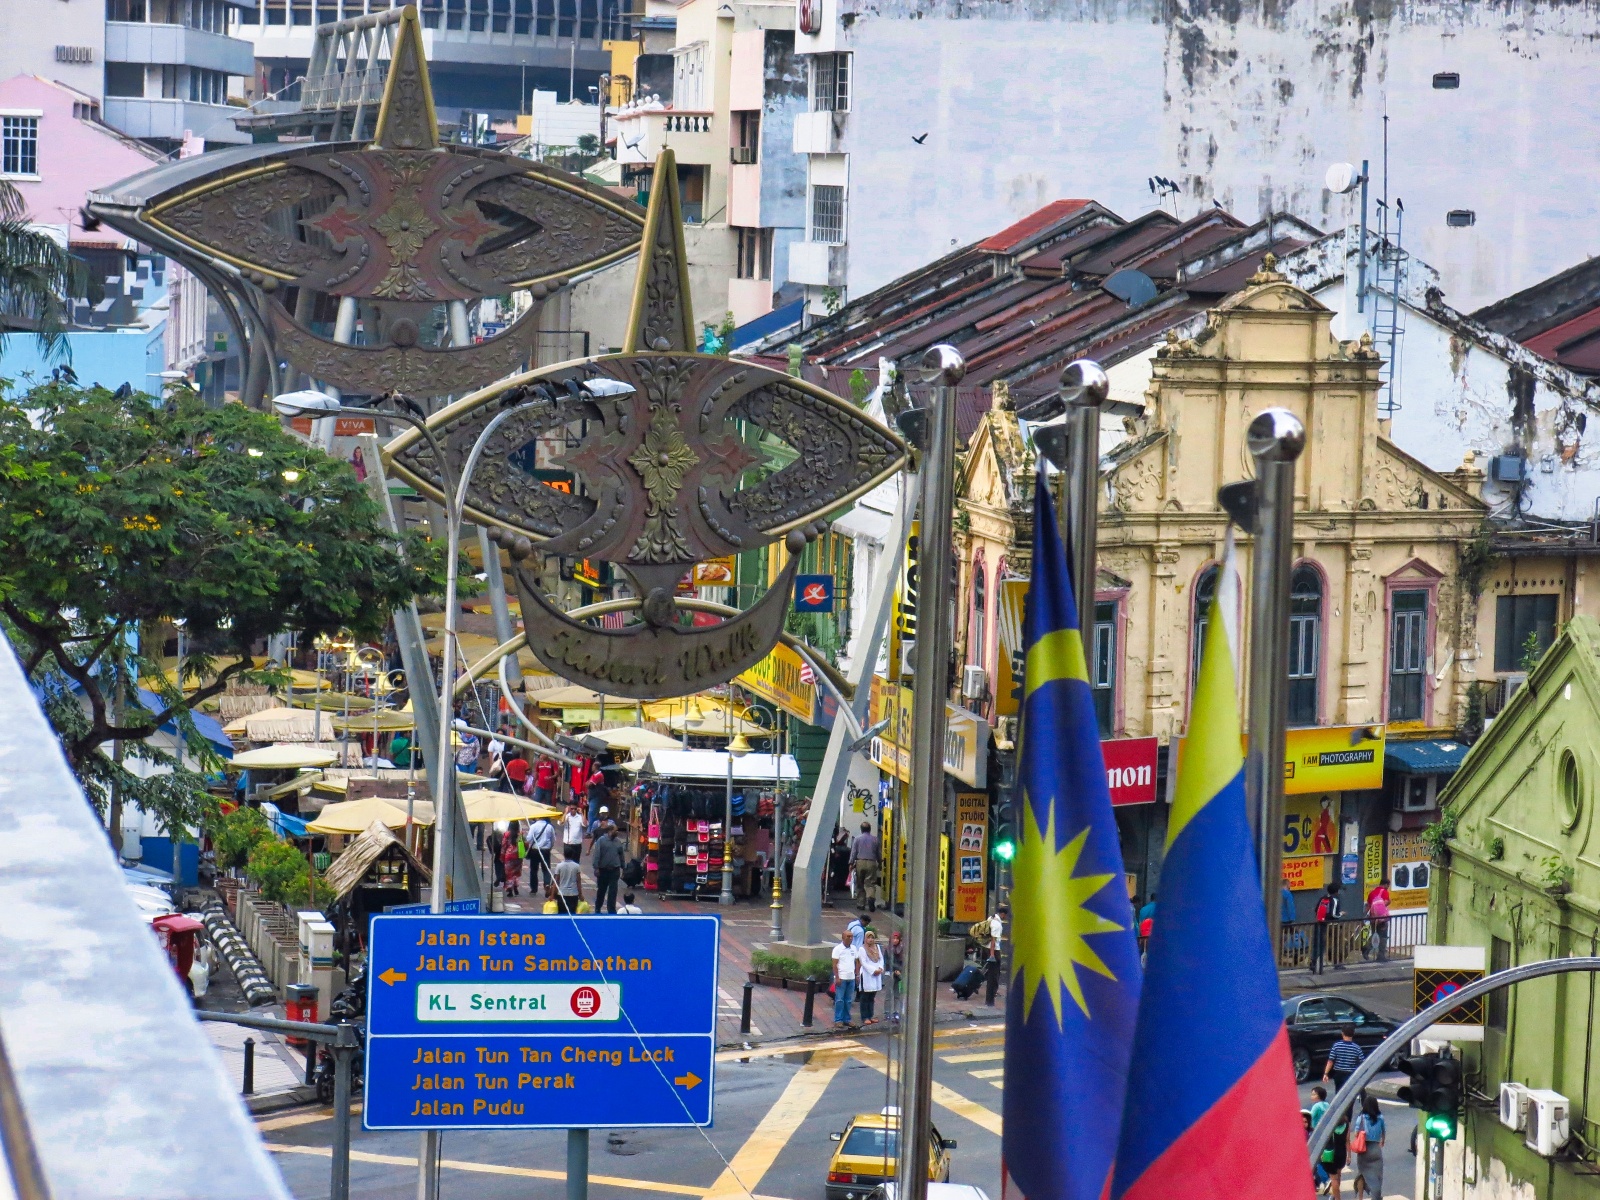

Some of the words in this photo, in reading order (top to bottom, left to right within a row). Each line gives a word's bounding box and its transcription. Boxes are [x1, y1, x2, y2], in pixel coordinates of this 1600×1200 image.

[1306, 755, 1318, 765] AM
[1320, 751, 1374, 764] PHOTOGRAPHY
[1107, 764, 1151, 789] non
[960, 798, 985, 807] DIGITAL
[960, 812, 985, 821] STUDIO
[1392, 847, 1409, 859] PRICE
[1283, 859, 1319, 870] ssport
[446, 905, 459, 913] HENG
[462, 902, 477, 912] LOCK
[417, 930, 470, 946] Jalan
[480, 930, 546, 946] Istana
[416, 955, 470, 971] Jalan
[479, 955, 514, 971] Tun
[524, 955, 652, 971] Sambanthan
[429, 994, 456, 1011] KL
[470, 993, 547, 1011] Sentral
[413, 1047, 466, 1063] Jalan
[476, 1047, 509, 1063] Tun
[519, 1047, 552, 1063] Tan
[561, 1046, 622, 1066] Cheng
[629, 1046, 674, 1063] Lock
[412, 1074, 465, 1090] Jalan
[475, 1073, 509, 1089] Tun
[518, 1073, 575, 1089] Perak
[411, 1100, 464, 1116] Jalan
[473, 1099, 524, 1116] Pudu
